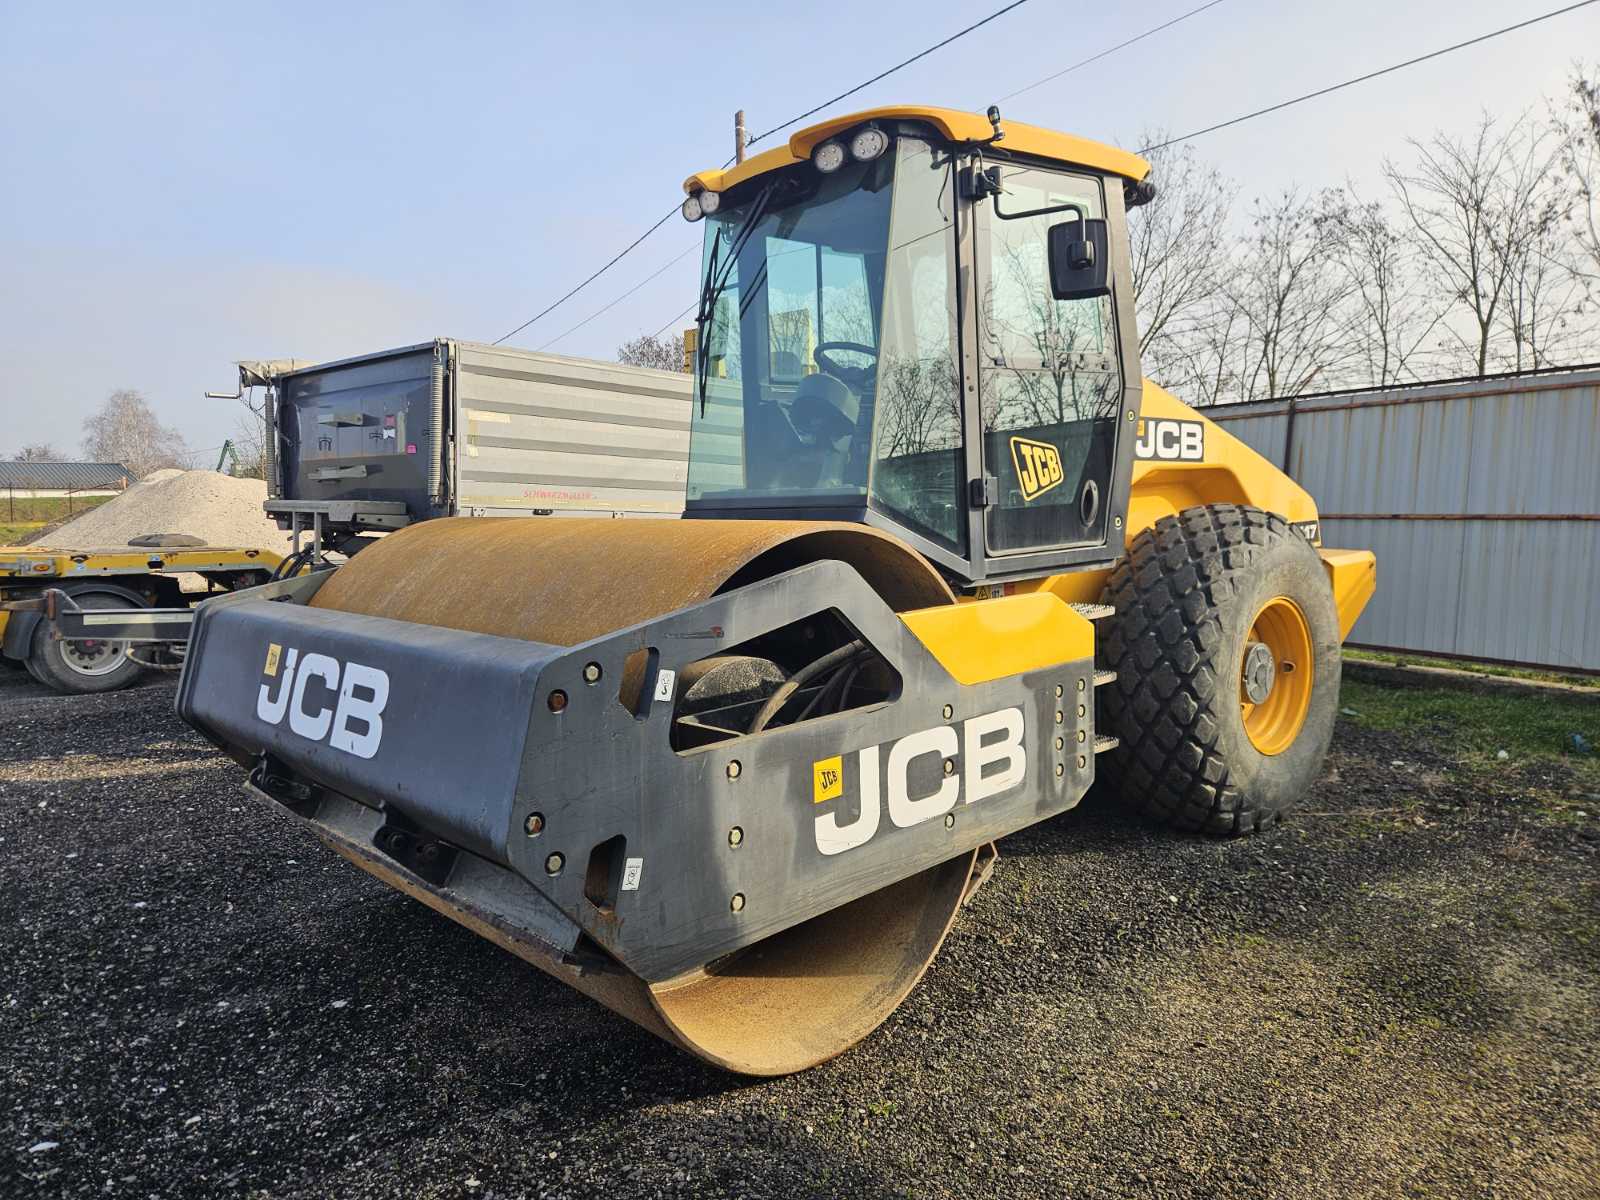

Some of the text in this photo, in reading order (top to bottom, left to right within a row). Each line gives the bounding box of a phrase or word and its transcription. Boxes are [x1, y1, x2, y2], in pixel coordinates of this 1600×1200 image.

[1135, 420, 1203, 459] JCB
[1020, 443, 1061, 494] JCB
[256, 646, 390, 760] JCB
[814, 707, 1027, 856] JCB
[821, 770, 838, 790] JCB
